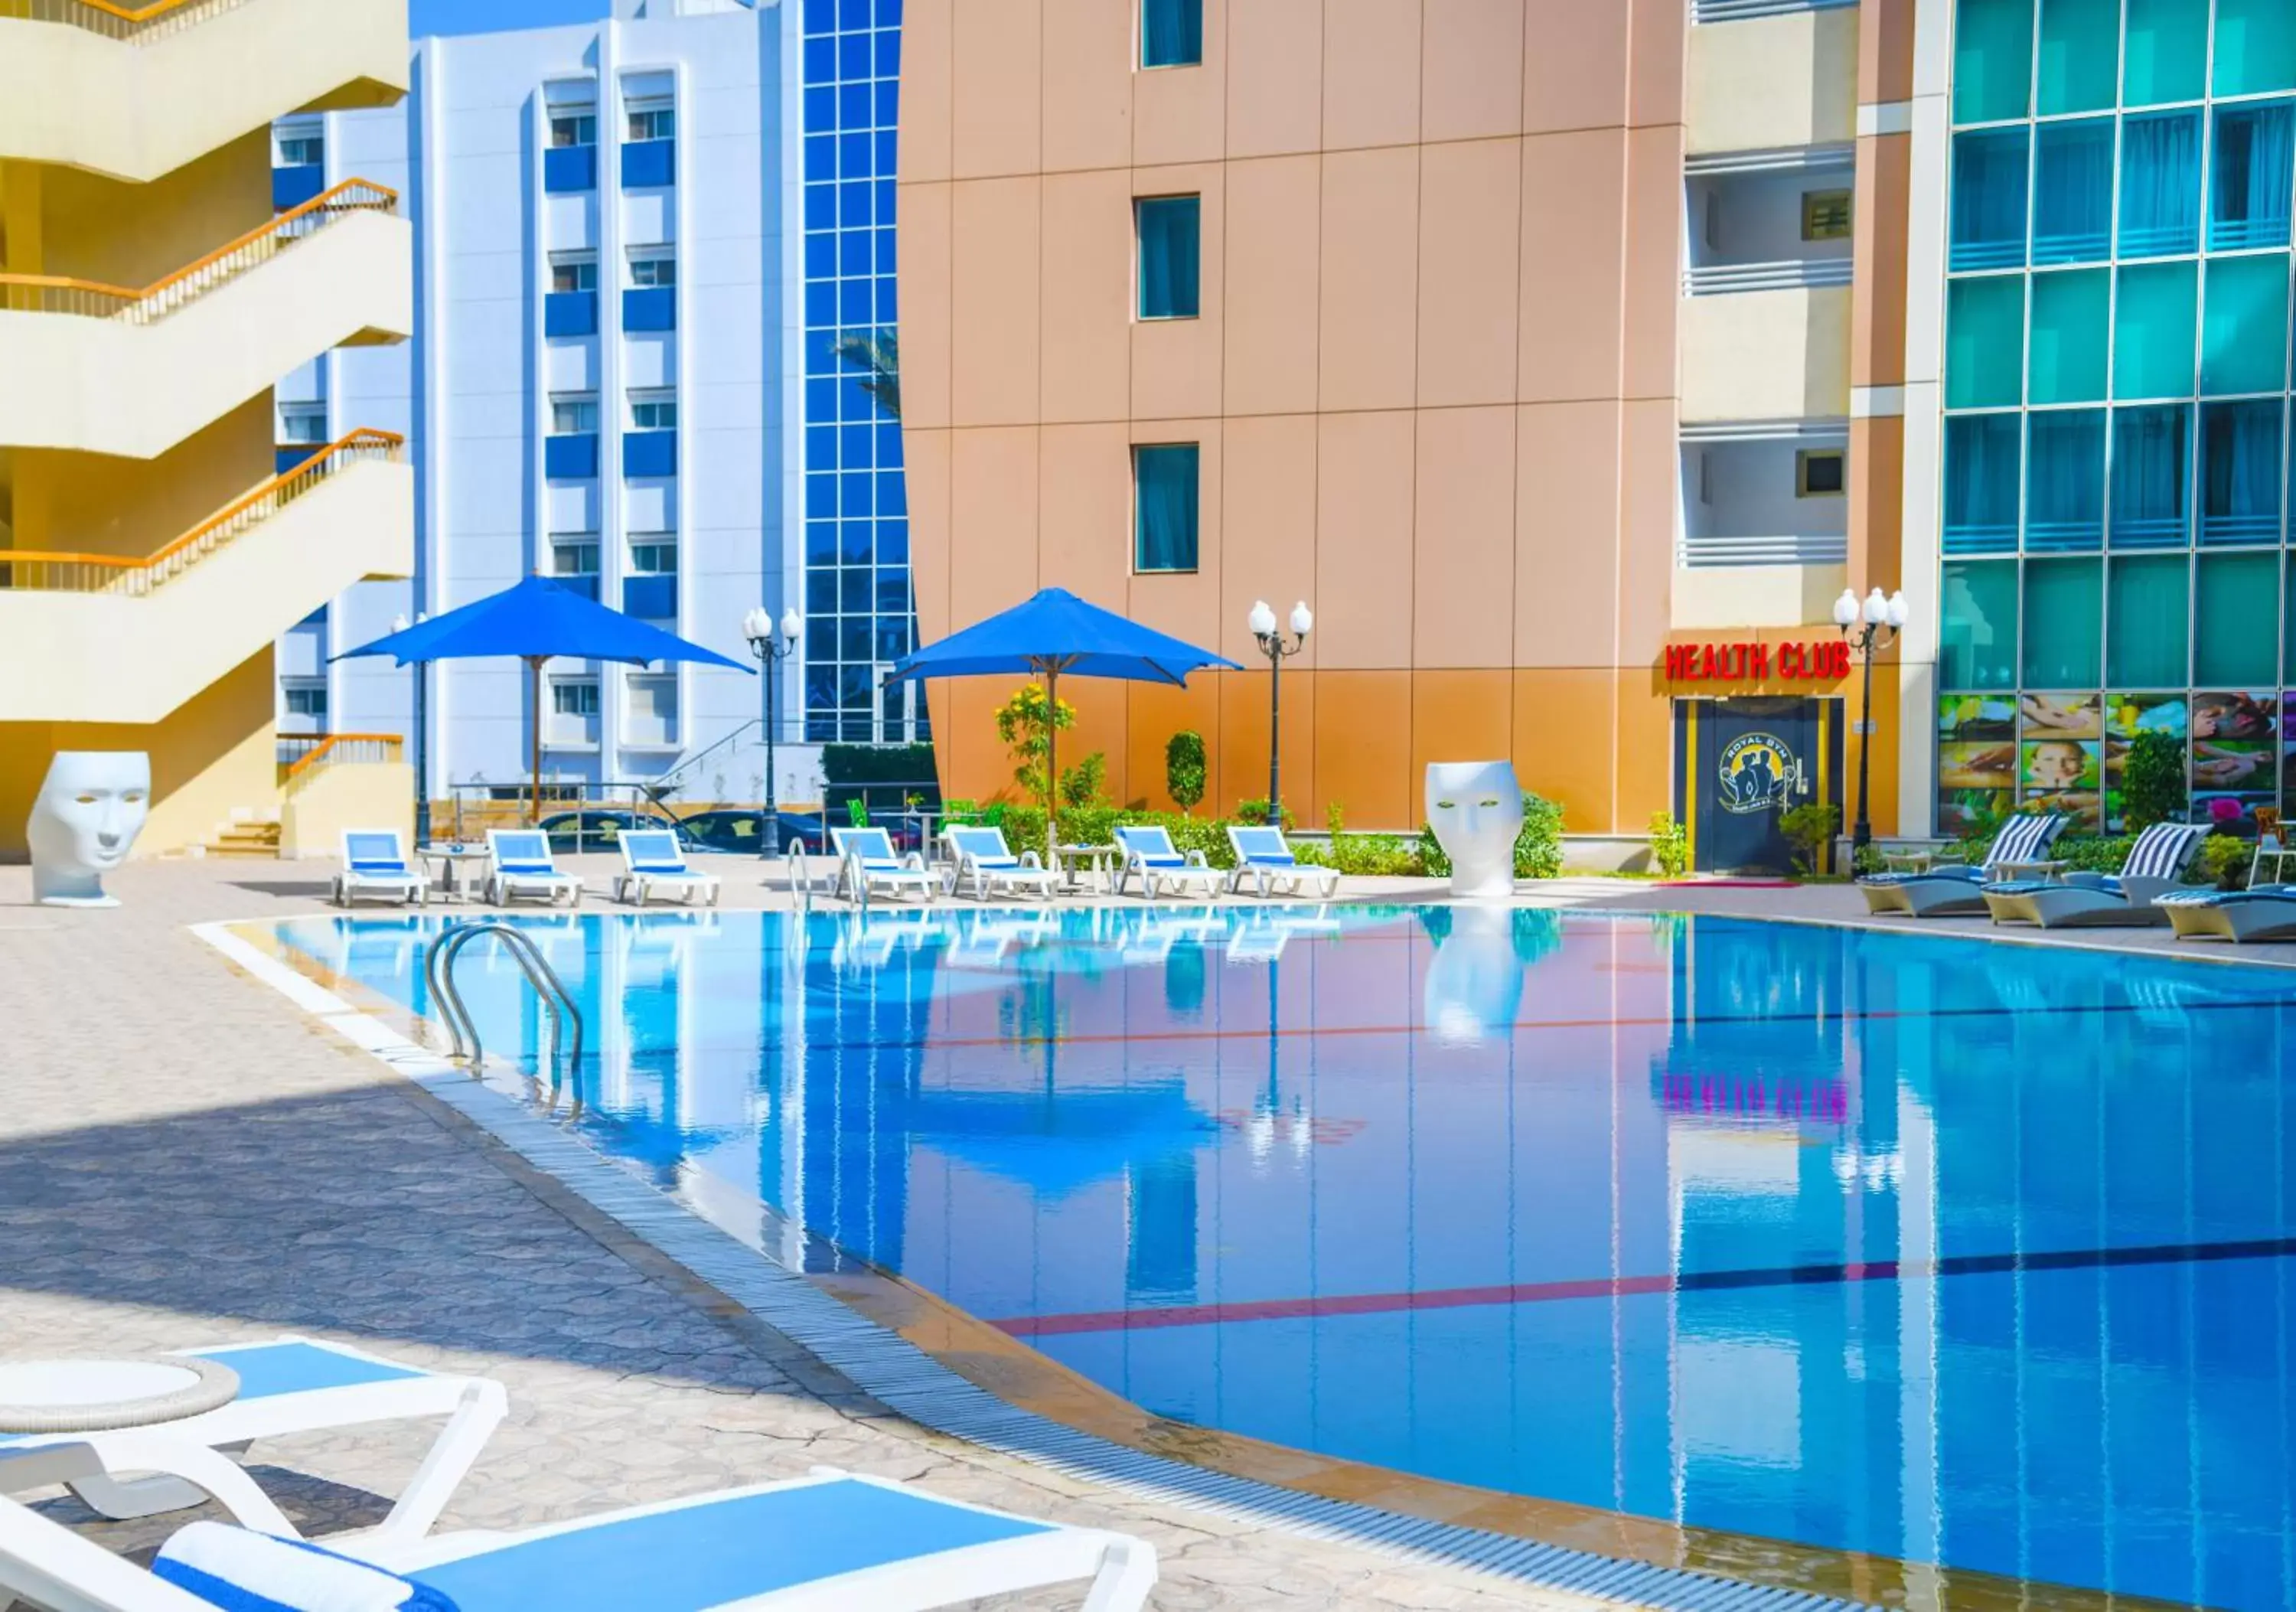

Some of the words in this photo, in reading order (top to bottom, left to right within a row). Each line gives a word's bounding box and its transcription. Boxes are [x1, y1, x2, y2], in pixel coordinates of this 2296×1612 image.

[1665, 643, 1769, 680] HEALTH
[1776, 641, 1851, 680] CLUB
[1727, 736, 1763, 759] ROYAL
[1766, 738, 1788, 759] GYM
